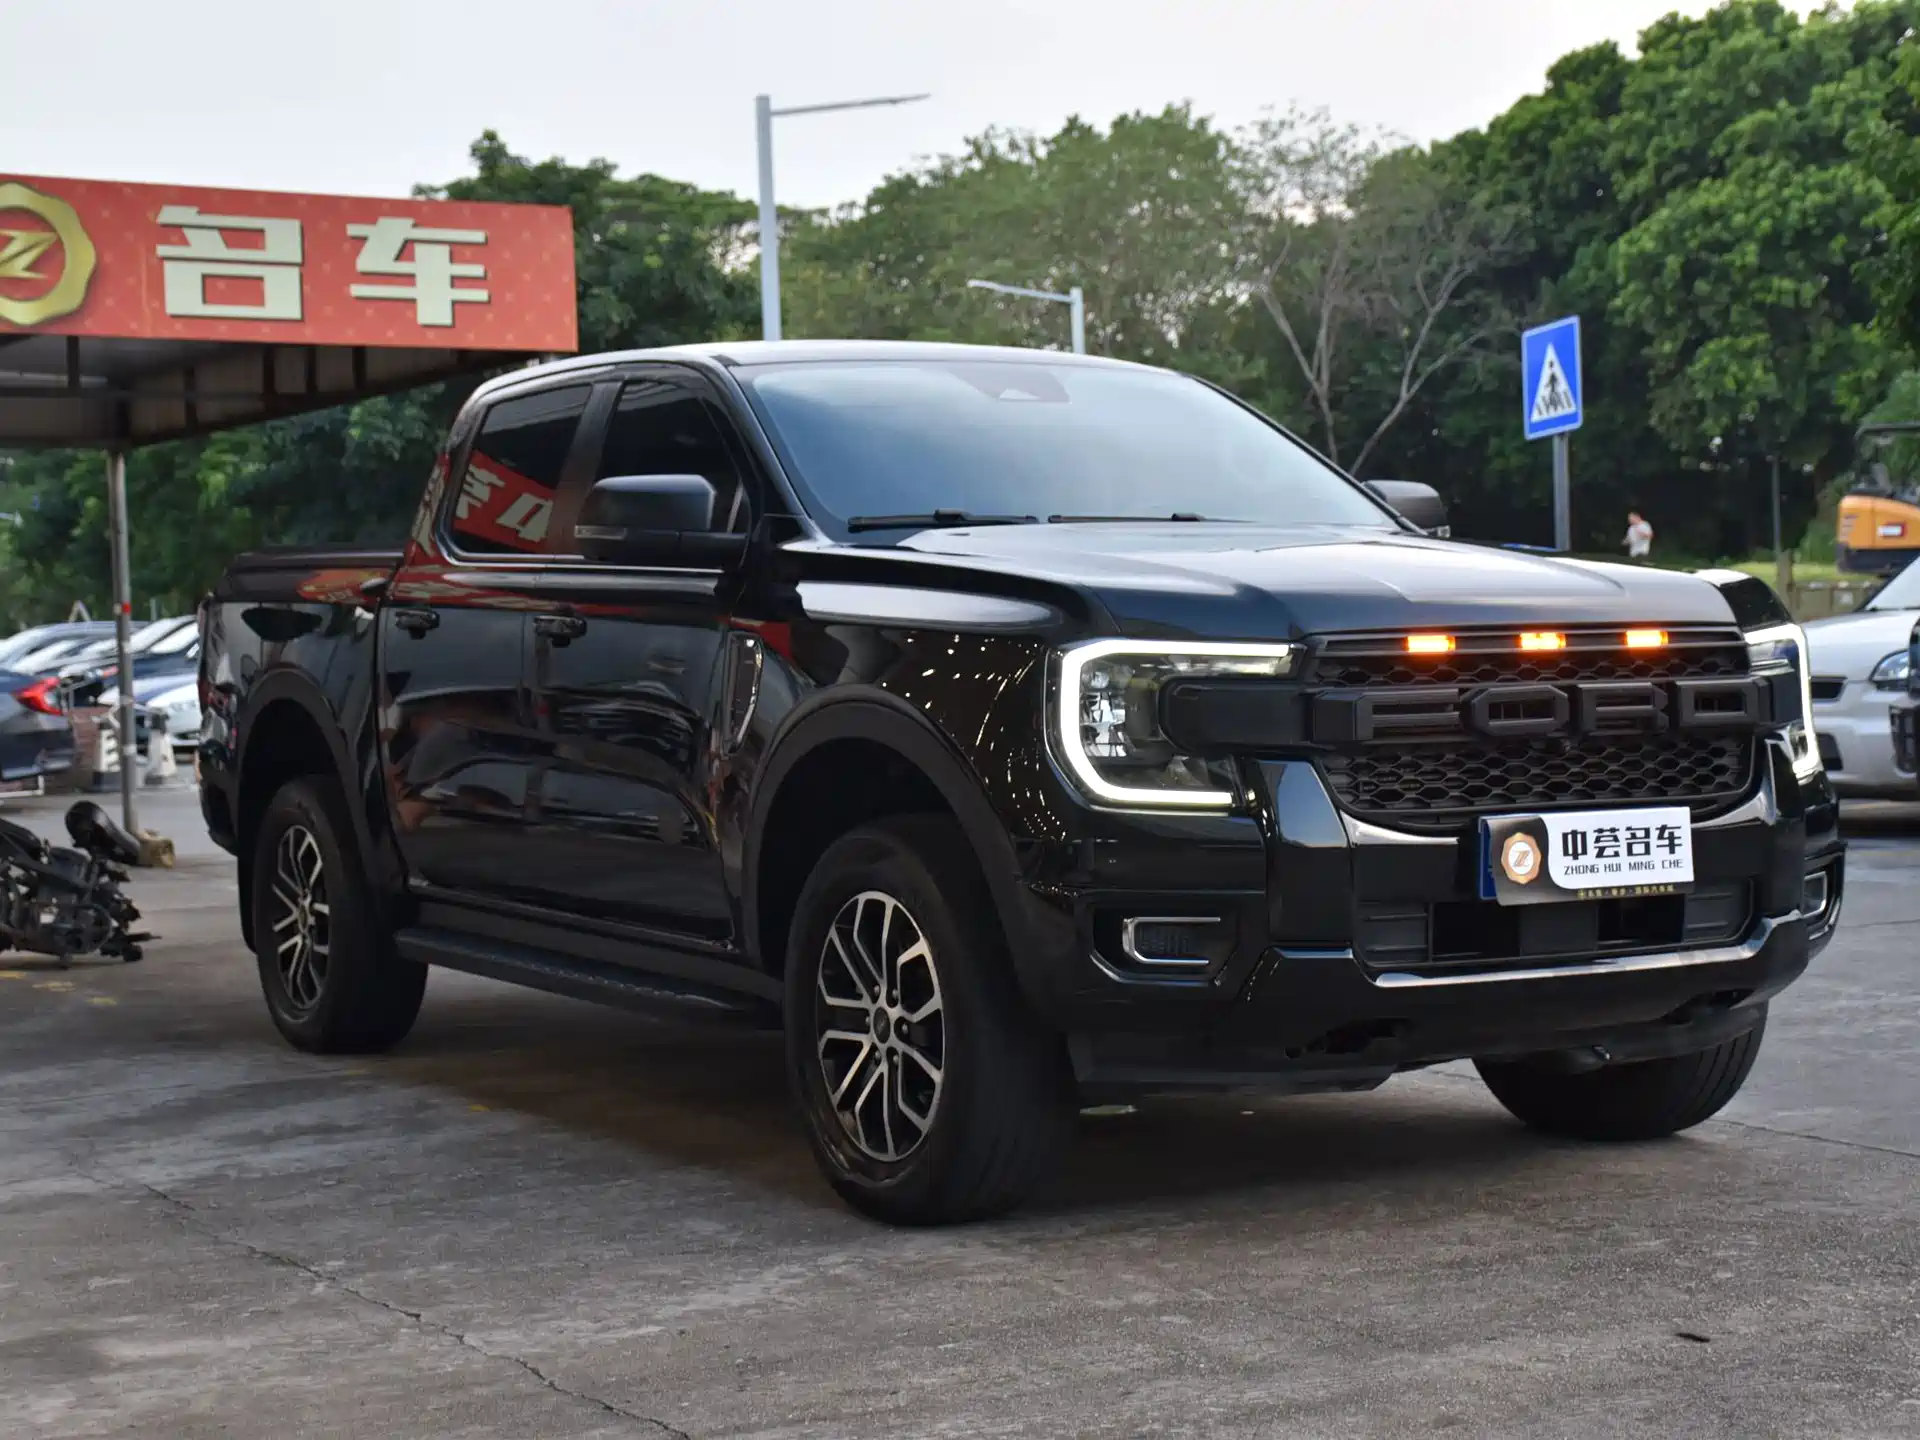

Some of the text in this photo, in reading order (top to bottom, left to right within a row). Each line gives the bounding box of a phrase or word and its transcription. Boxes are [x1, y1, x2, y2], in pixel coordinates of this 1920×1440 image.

[156, 204, 491, 327] 名车
[1350, 678, 1764, 742] FORD
[1561, 823, 1682, 861] 中荟名车
[1563, 858, 1684, 875] ZHONG HUI MING CHE
